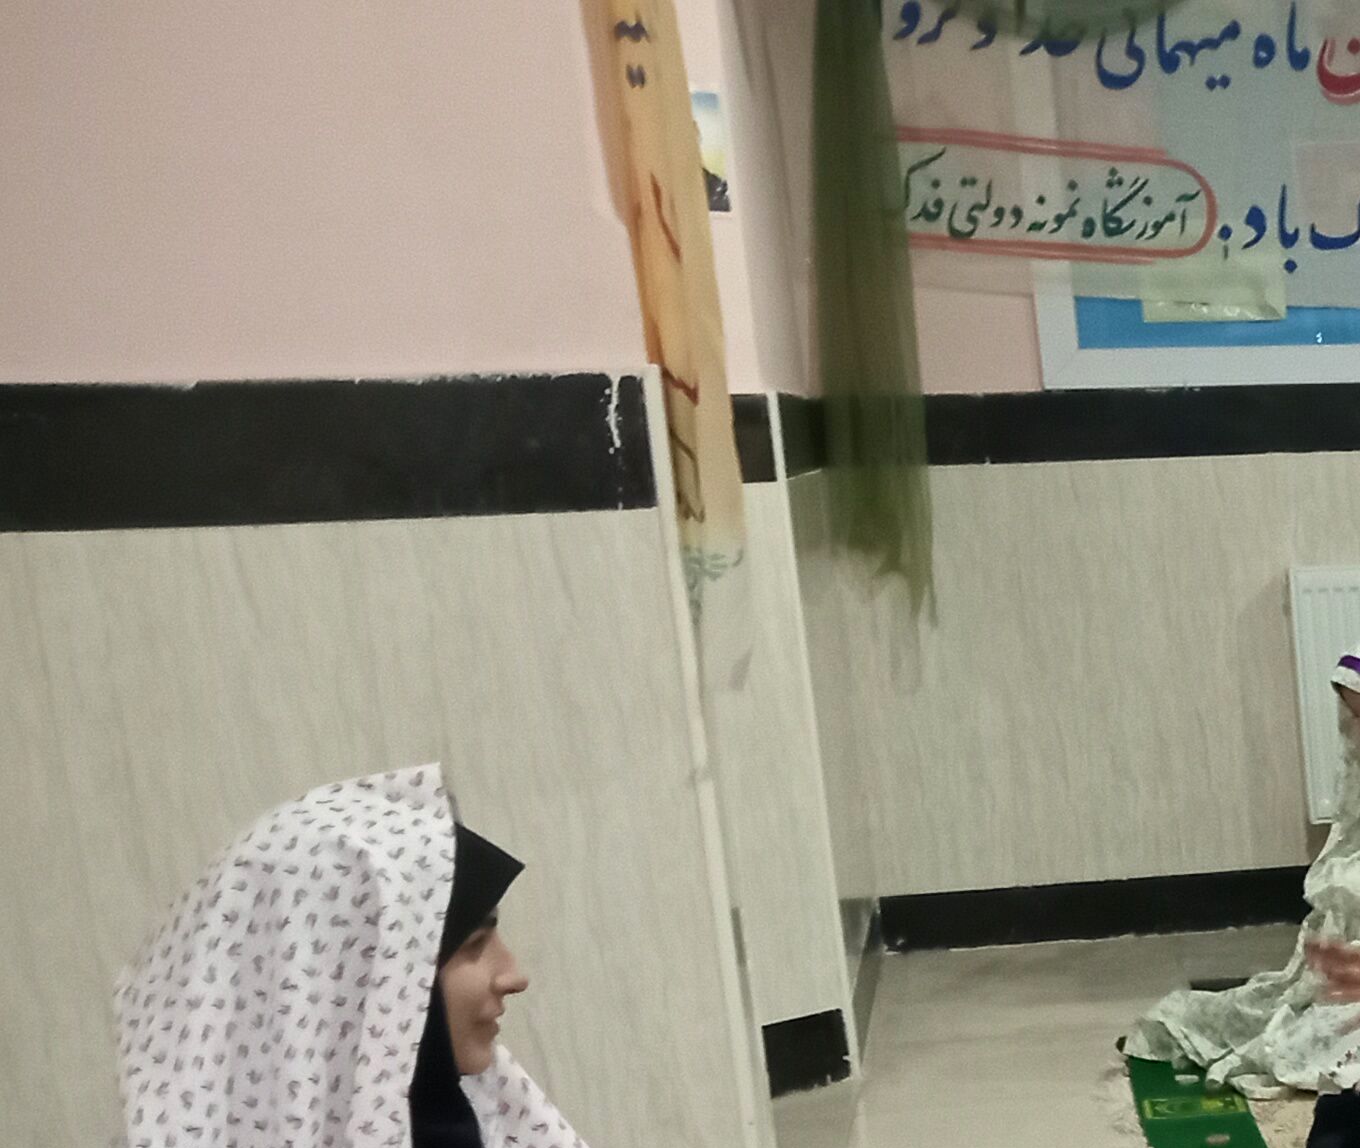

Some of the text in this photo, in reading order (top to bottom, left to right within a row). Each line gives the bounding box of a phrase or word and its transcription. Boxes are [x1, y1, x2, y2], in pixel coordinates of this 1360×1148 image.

[1252, 0, 1310, 72] ماه
[946, 178, 1024, 240] دولتی
[1026, 178, 1081, 235] نمونه
[1080, 166, 1201, 241] آموزشگاه
